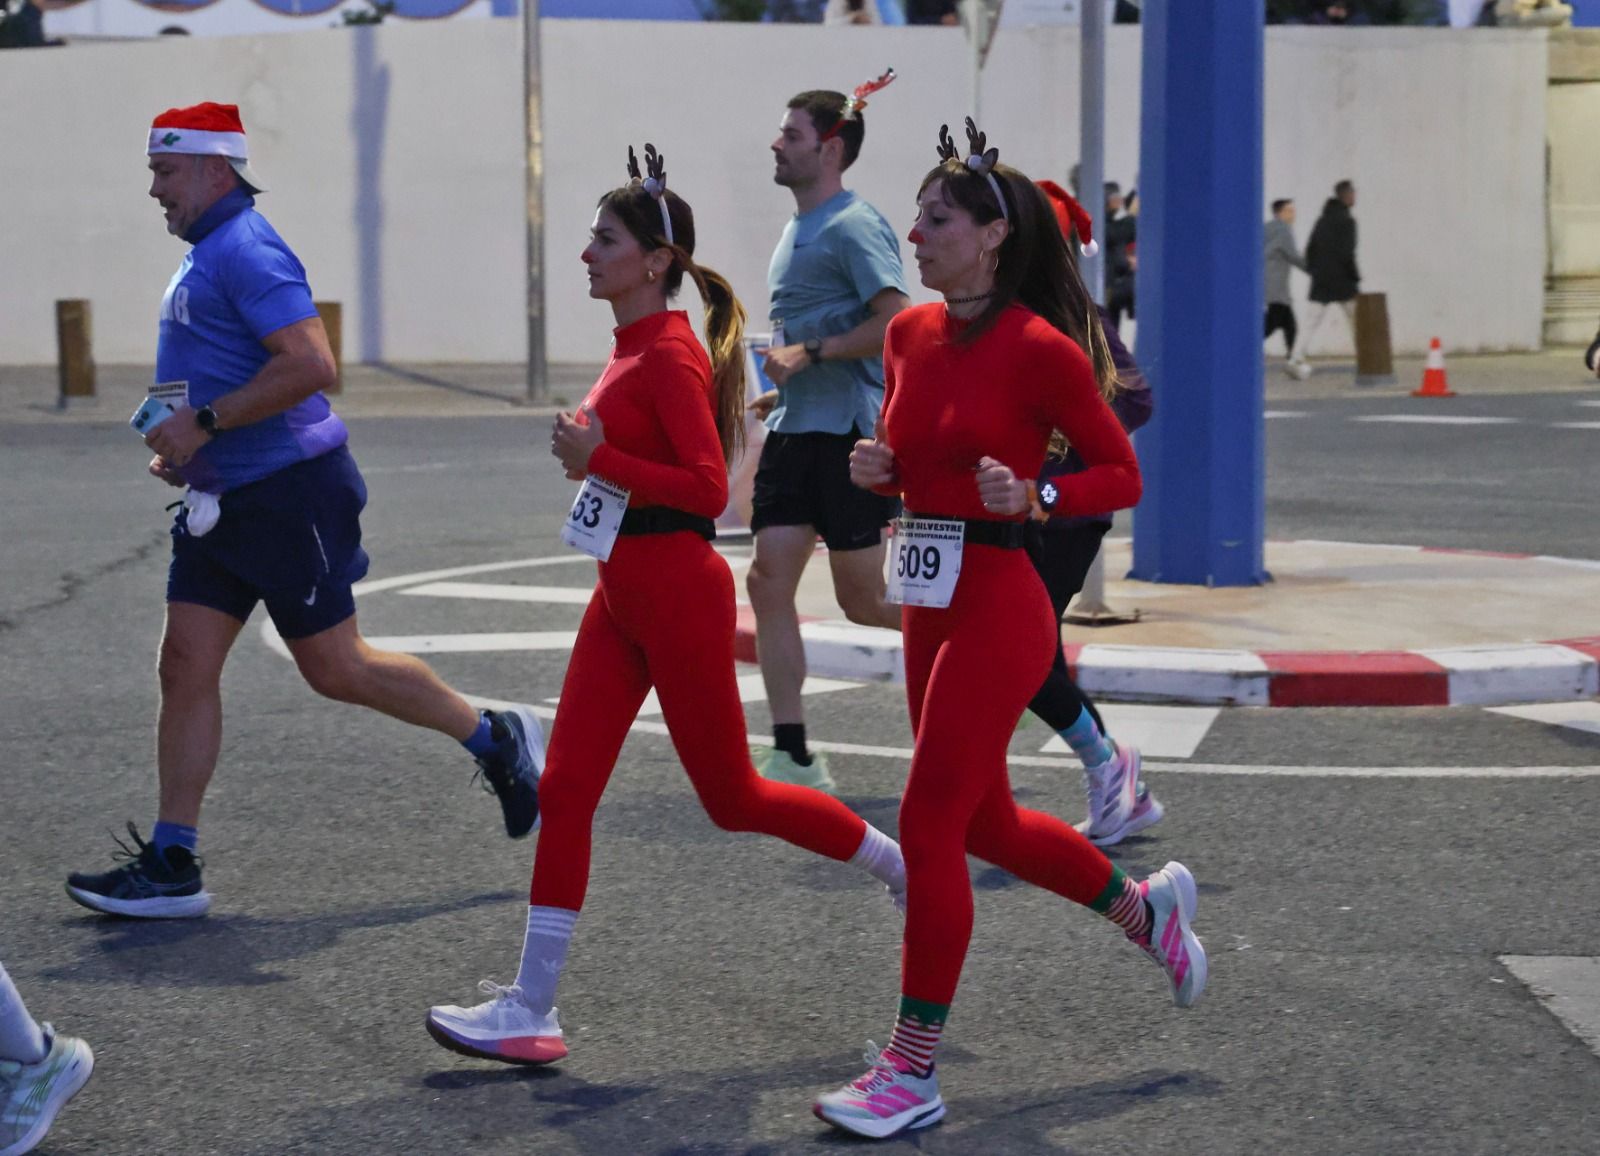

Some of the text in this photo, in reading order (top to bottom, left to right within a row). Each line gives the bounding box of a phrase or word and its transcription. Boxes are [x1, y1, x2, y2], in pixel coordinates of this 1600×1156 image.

[569, 491, 603, 529] 53
[916, 522, 963, 532] SILVESTRE
[897, 544, 941, 580] 509
